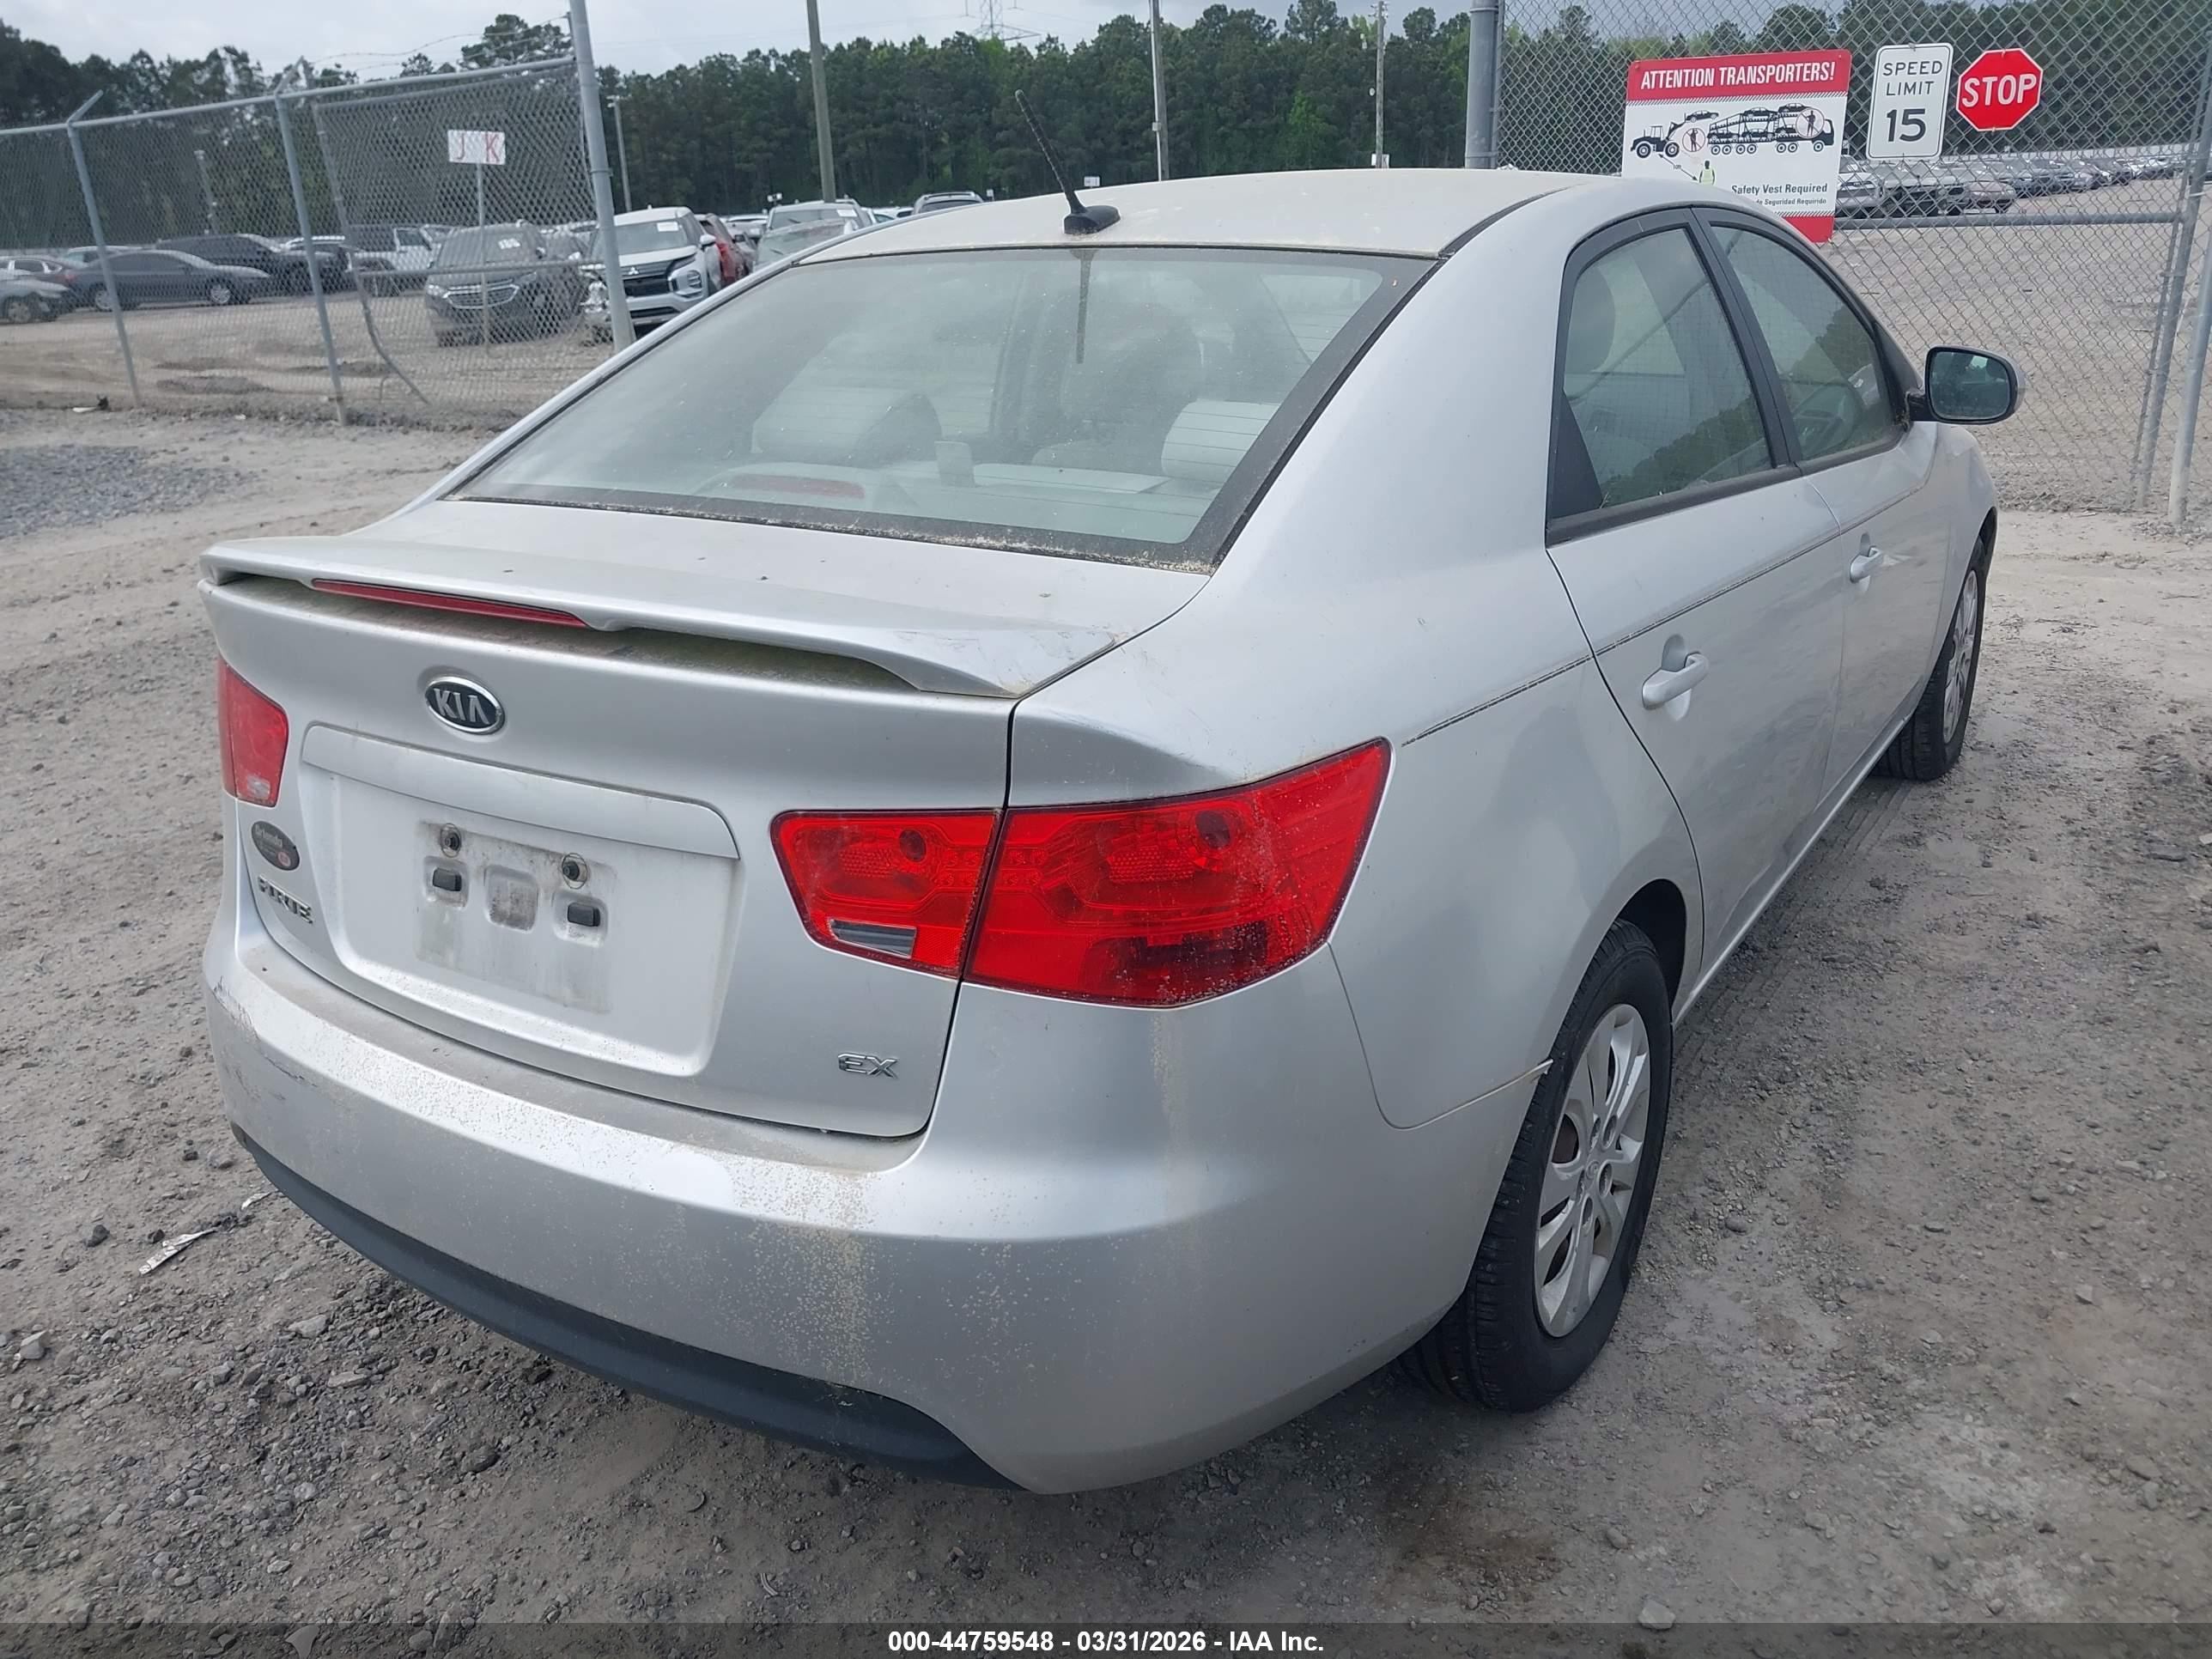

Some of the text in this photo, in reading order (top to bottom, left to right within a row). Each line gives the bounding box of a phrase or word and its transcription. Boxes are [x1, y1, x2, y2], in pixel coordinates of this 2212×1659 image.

[1641, 62, 1836, 89] ATTENTION TRANSPORTERS!
[1883, 61, 1943, 76] SPEED
[1886, 81, 1935, 96] LIMIT
[1961, 73, 2037, 108] STOP
[1886, 108, 1927, 143] 15
[484, 131, 501, 162] K
[1731, 183, 1828, 196] Safety Vest Required
[434, 688, 490, 725] KIA
[837, 1053, 898, 1079] EX
